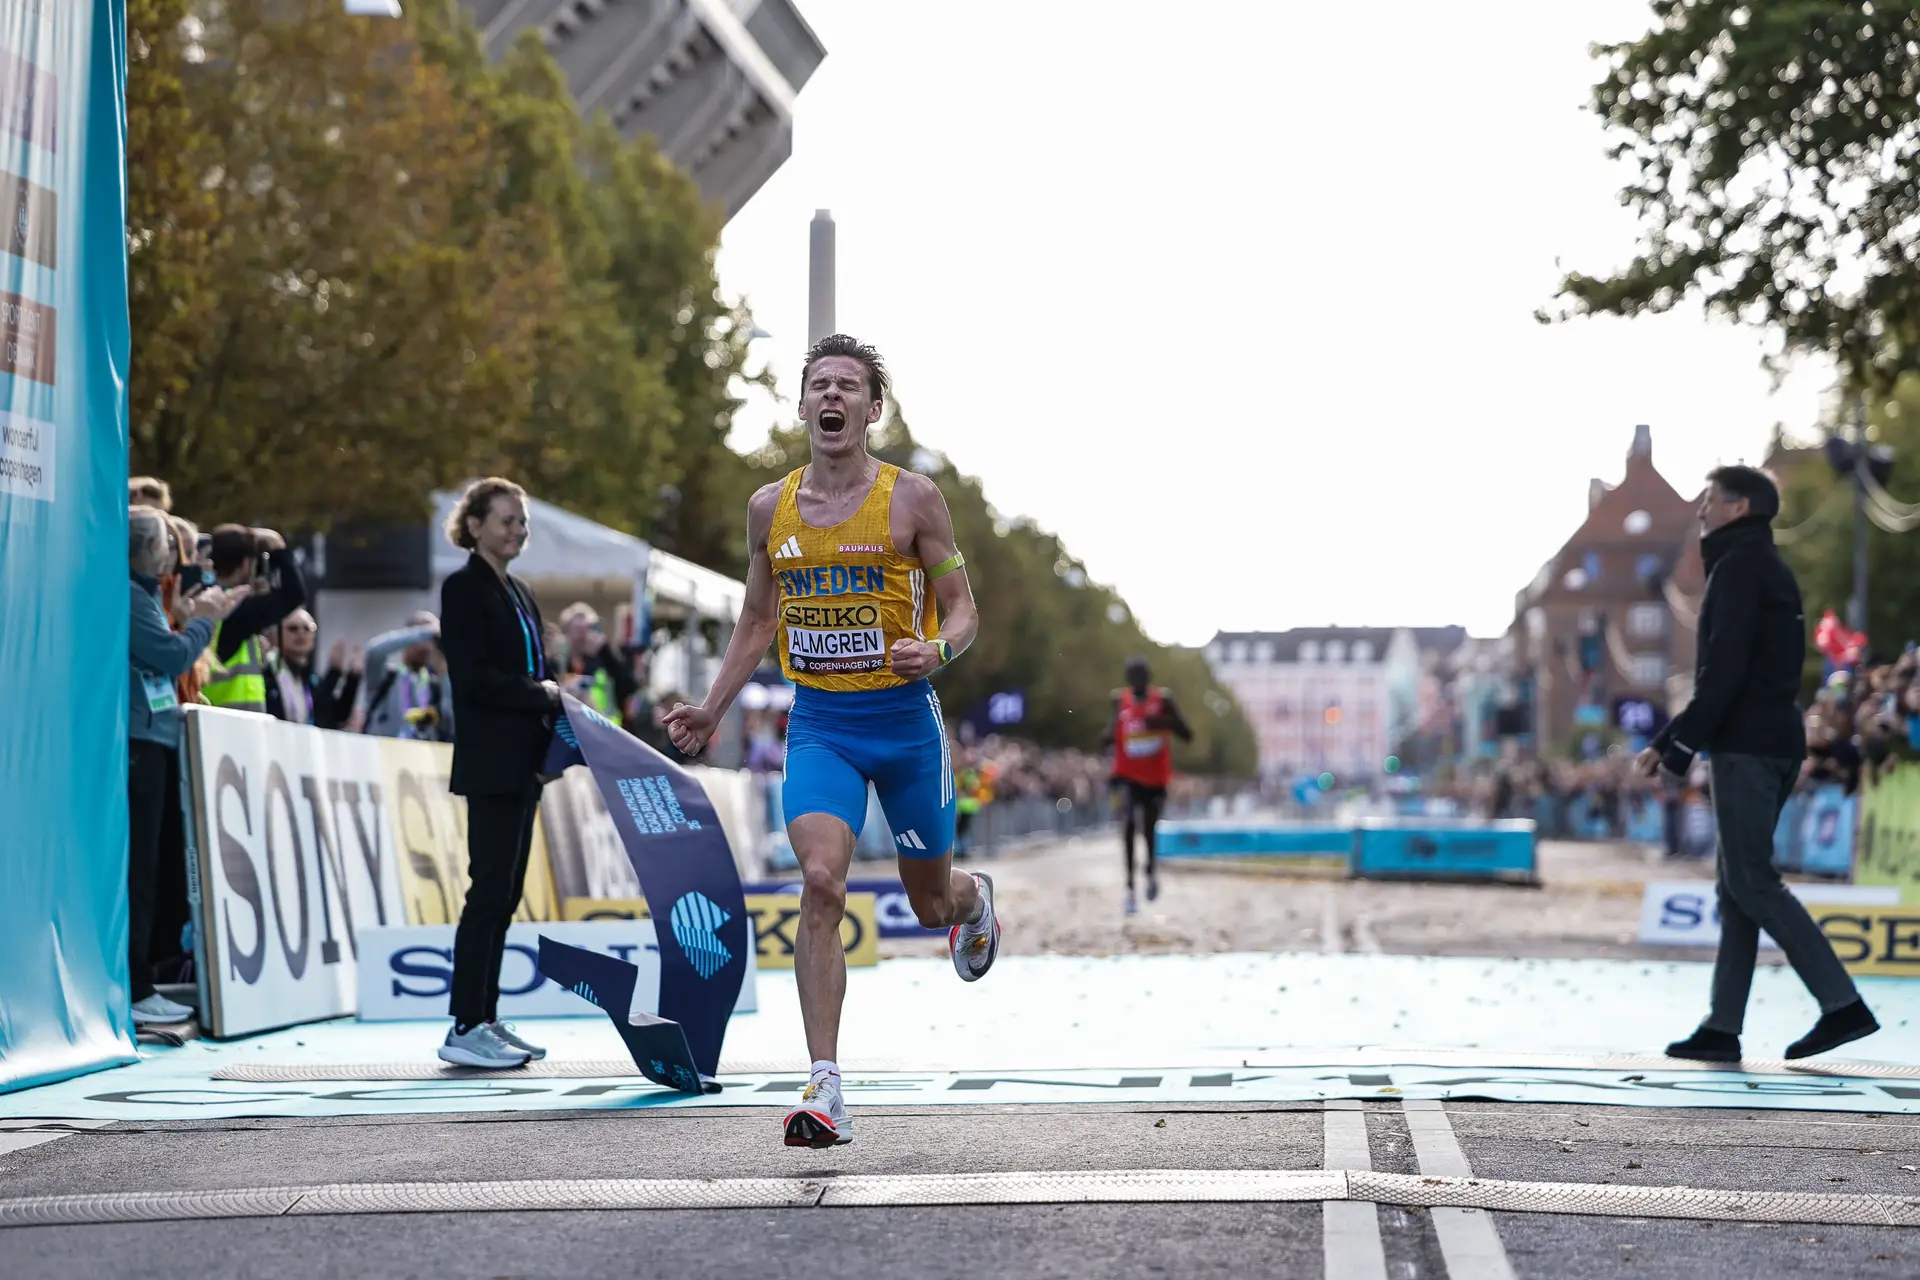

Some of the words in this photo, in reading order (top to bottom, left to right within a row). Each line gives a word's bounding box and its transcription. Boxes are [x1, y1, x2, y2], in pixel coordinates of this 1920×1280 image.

[779, 565, 885, 597] SWEDEN
[785, 605, 878, 627] SEIKO
[792, 630, 879, 655] ALMGREN
[809, 660, 870, 670] COPENHAGEN
[215, 754, 388, 986] SONY
[83, 1072, 1920, 1106] COPENHAG
